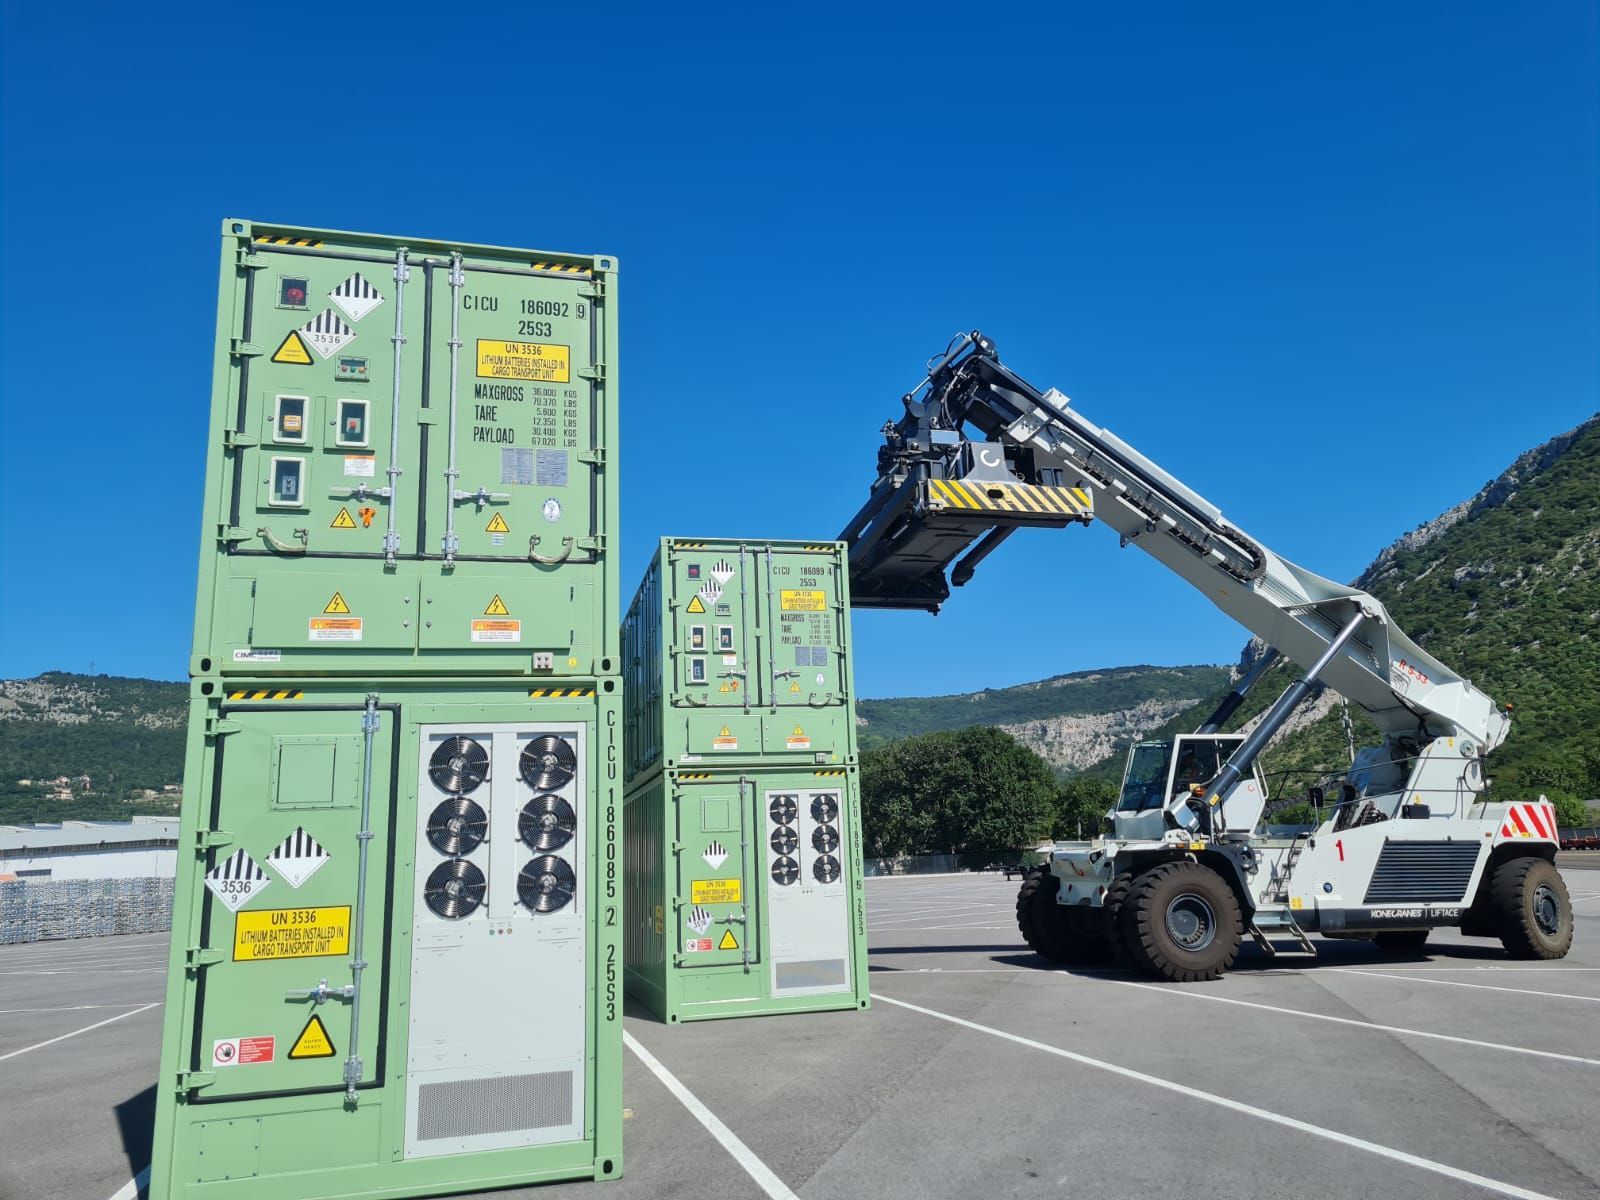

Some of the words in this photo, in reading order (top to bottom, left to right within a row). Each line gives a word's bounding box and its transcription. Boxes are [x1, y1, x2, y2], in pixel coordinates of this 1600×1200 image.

[463, 295, 498, 312] CICU
[520, 299, 569, 317] 186092
[577, 304, 585, 319] 9
[518, 320, 552, 337] 25S3
[314, 334, 341, 344] 3536
[505, 344, 519, 354] UN
[521, 345, 542, 356] 3536
[481, 354, 503, 366] LITHIUM
[504, 356, 531, 368] BATTERIES
[531, 358, 558, 369] INSTALLED
[559, 360, 565, 369] IN
[491, 366, 511, 377] CARGO
[511, 367, 541, 379] TRANSPORT
[541, 369, 555, 380] UNIT
[474, 384, 524, 402] MAXGROSS
[564, 390, 577, 398] KGS
[564, 400, 577, 408] LBS
[475, 405, 498, 421] TARE
[564, 409, 577, 417] KGS
[564, 419, 576, 428] LBS
[473, 426, 515, 444] PAYLOAD
[564, 429, 576, 438] KGS
[564, 439, 576, 447] LBS
[799, 578, 817, 587] 25S3
[607, 710, 616, 780] CICU
[606, 788, 615, 898] 186085
[1336, 839, 1344, 862] 1
[220, 880, 251, 894] 3536
[231, 895, 238, 903] 9
[271, 911, 288, 925] UN
[291, 910, 317, 924] 3536
[606, 907, 615, 926] 2
[1370, 908, 1422, 919] KONECRANES
[1430, 908, 1459, 917] LIFTACE
[241, 929, 267, 944] LITHIUM
[269, 928, 301, 942] BATTERIES
[302, 926, 336, 940] INSTALLED
[337, 926, 344, 938] IN
[253, 943, 275, 957] CARGO
[276, 940, 314, 955] TRANSPORT
[315, 939, 331, 953] UNIT
[606, 944, 615, 1022] 25S3
